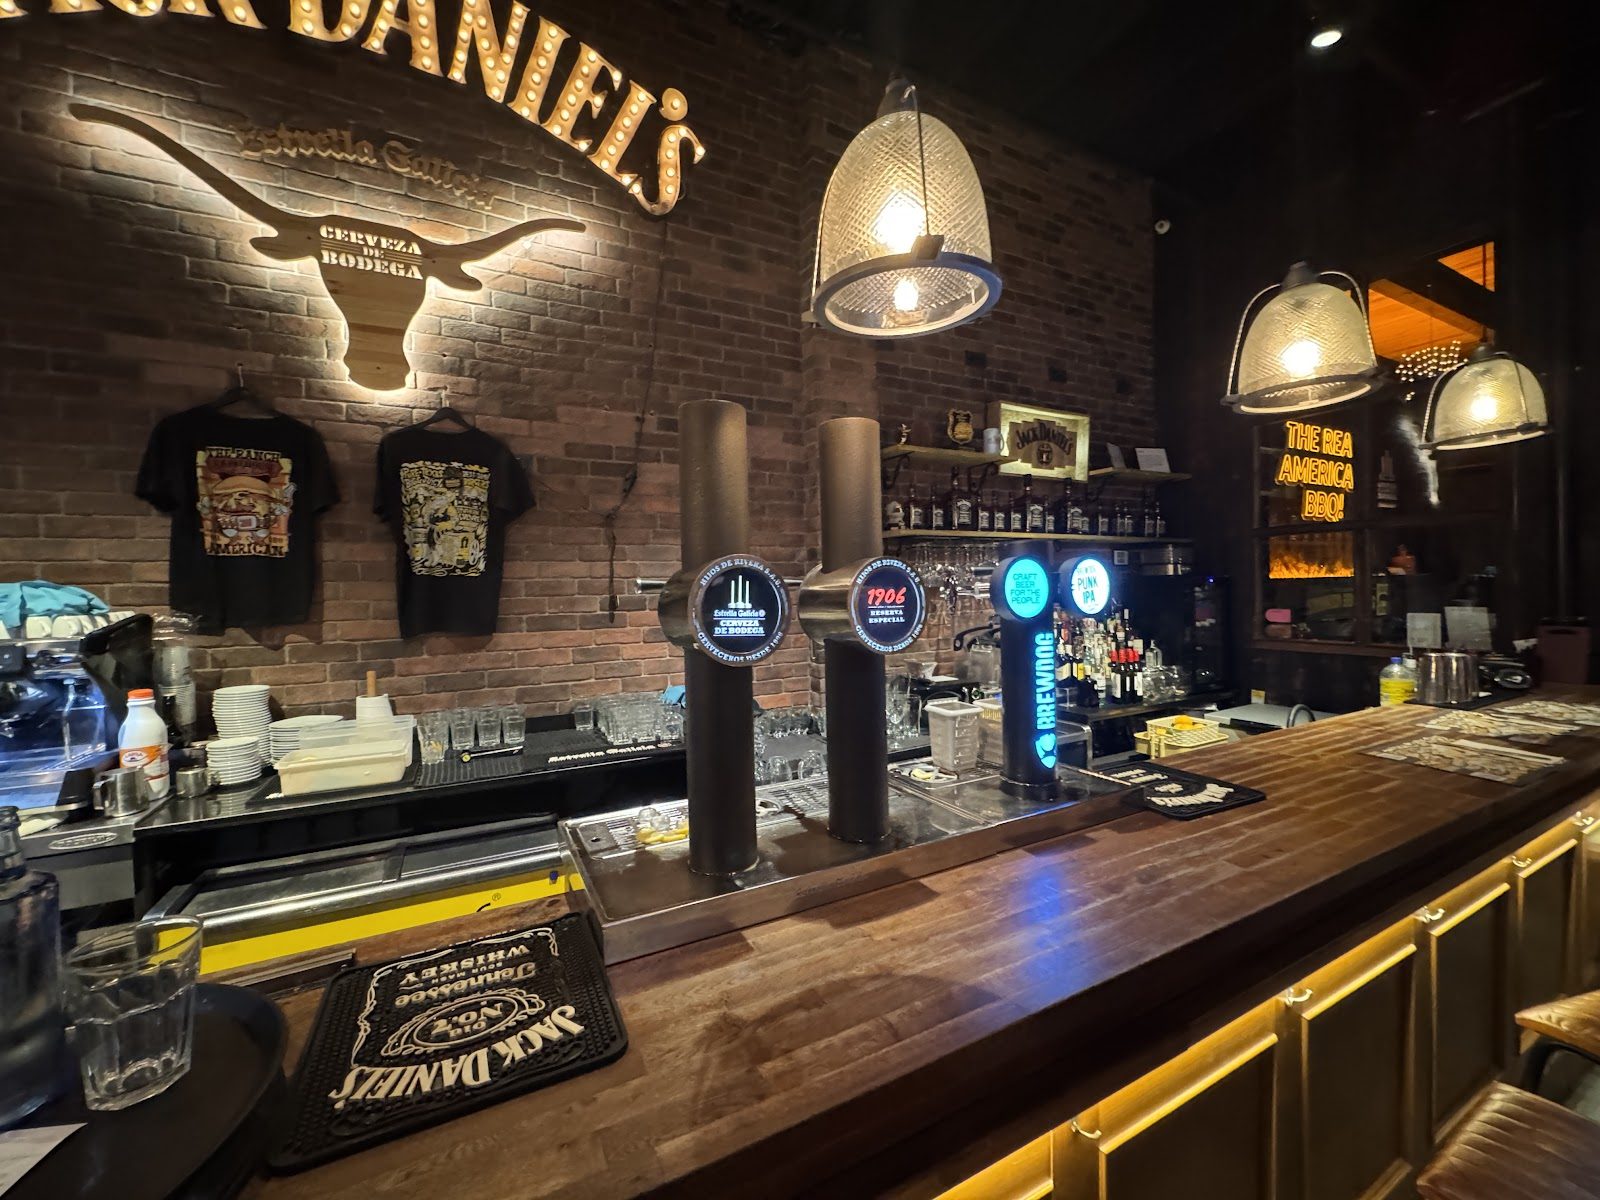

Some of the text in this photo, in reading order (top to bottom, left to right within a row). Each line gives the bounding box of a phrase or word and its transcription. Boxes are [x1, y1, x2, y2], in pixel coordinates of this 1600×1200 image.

[319, 224, 422, 255] CERVEZA
[362, 246, 385, 259] DE
[320, 250, 424, 280] BODEGA
[1286, 420, 1354, 458] THE REA
[1278, 454, 1355, 489] AMERICA
[1304, 490, 1345, 522] BBQ!
[700, 565, 721, 586] HIJOS
[720, 559, 734, 569] DE
[734, 558, 765, 571] RIVERA
[856, 565, 873, 585] HIJOS
[882, 559, 907, 570] RIVERA
[1012, 573, 1038, 581] CRAFT
[1015, 581, 1036, 589] BEER
[1077, 576, 1098, 591] PUNK
[867, 587, 907, 606] 1906
[1011, 596, 1041, 605] PEOPLE
[1026, 589, 1041, 597] THE
[1082, 590, 1096, 605] IPA
[713, 609, 759, 617] Estrella Galicia
[719, 619, 760, 627] CERVEZA
[714, 627, 728, 635] DE
[855, 625, 893, 652] CERVECEROS
[697, 631, 745, 662] CERVECEROS
[745, 646, 772, 661] DESDE
[1034, 632, 1056, 730] BREWDOG
[399, 943, 530, 986] WHISKEY
[430, 962, 504, 984] SOUR MASH
[394, 962, 537, 1008] Tennessee
[328, 1004, 586, 1111] JACK DANIEL'S
